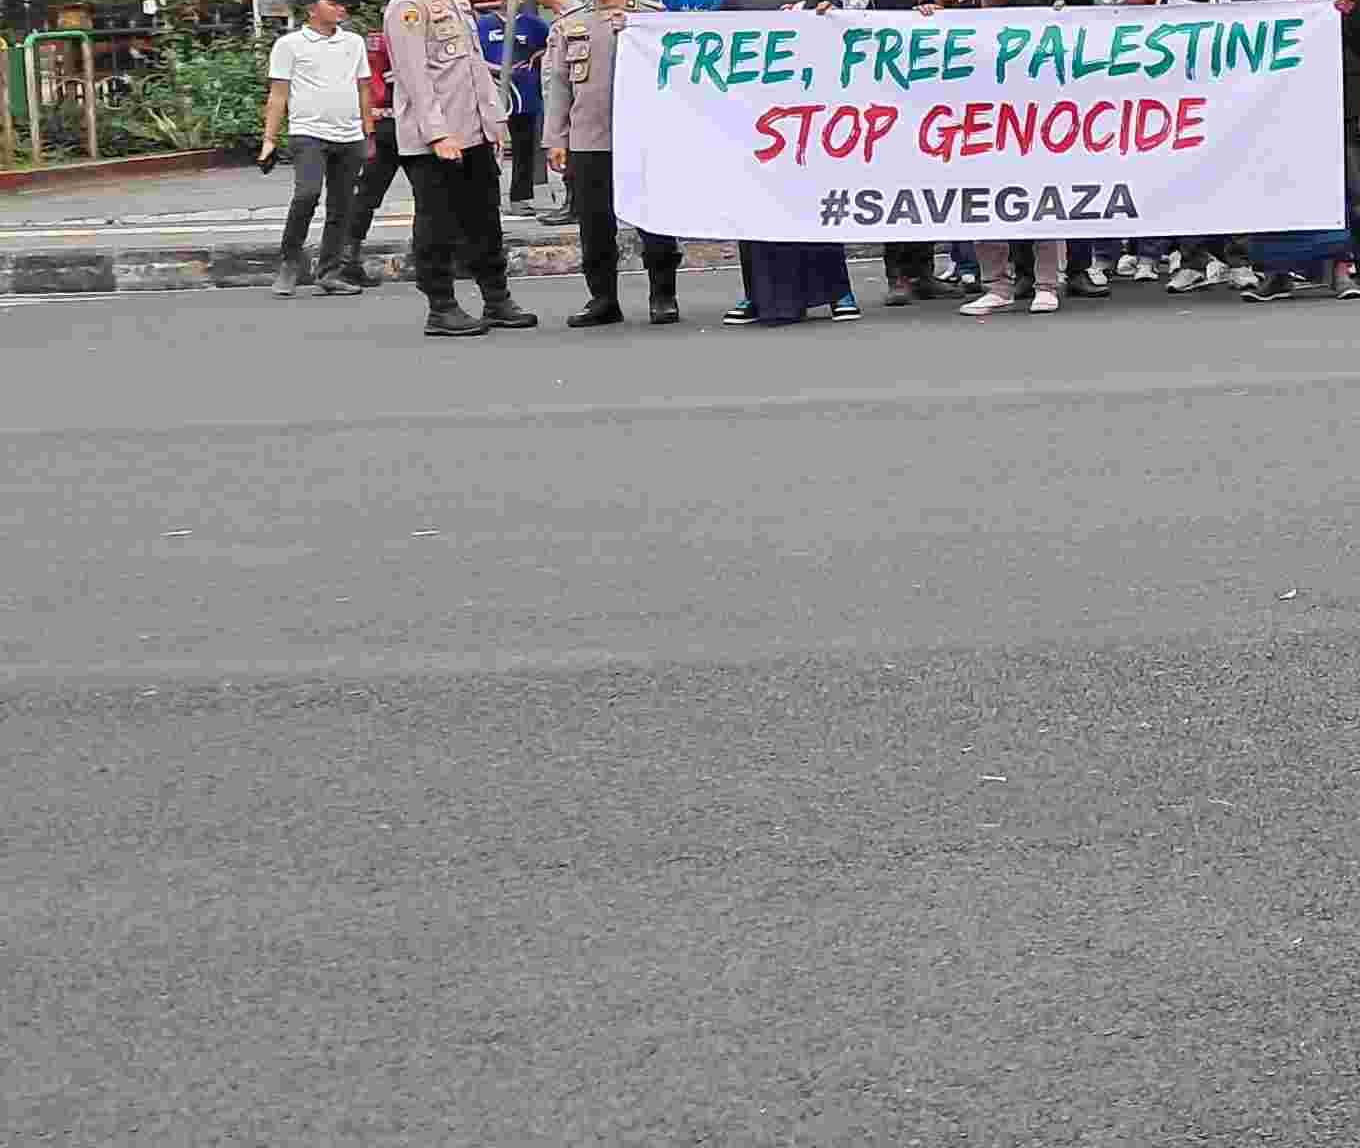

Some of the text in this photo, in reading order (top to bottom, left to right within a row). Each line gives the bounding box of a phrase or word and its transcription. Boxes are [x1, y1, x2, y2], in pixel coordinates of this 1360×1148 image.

[656, 17, 1305, 94] FREE, FREE PALESTINE
[752, 96, 1209, 167] STOP GENOCIDE
[819, 183, 1140, 228] #SAVEGAZA
